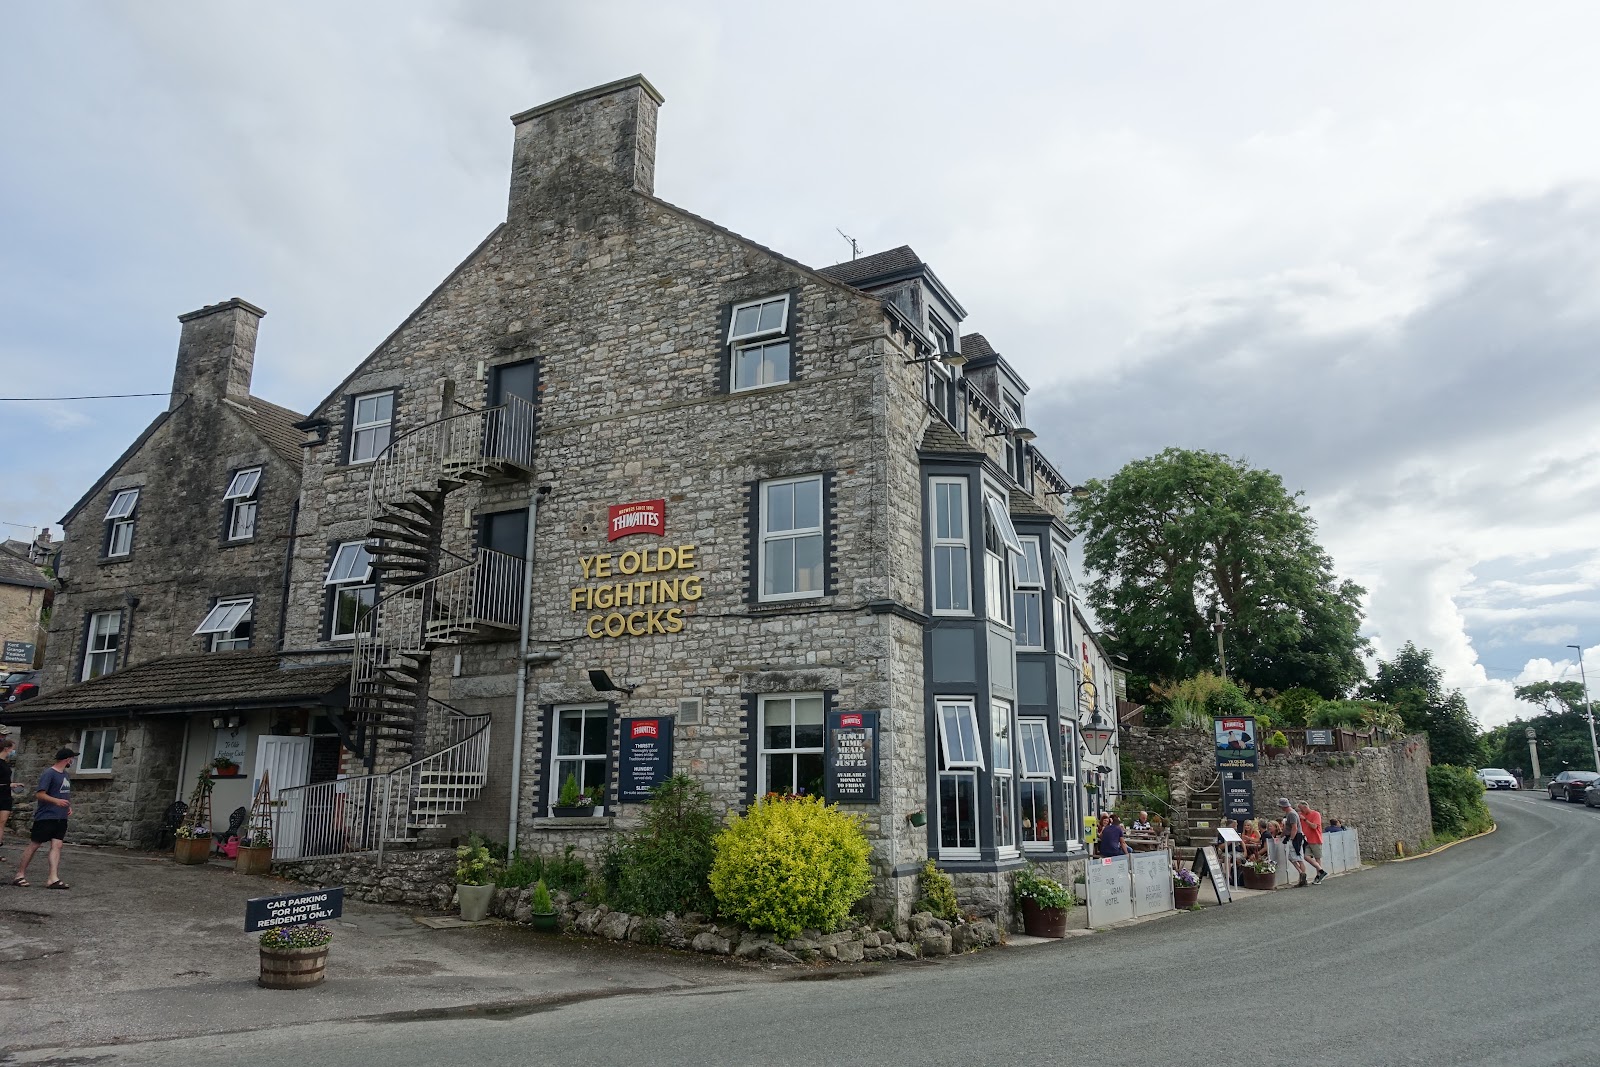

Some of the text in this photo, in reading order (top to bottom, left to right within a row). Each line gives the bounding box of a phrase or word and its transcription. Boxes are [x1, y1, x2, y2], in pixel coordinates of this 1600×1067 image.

[612, 512, 659, 532] THWAITES
[578, 544, 695, 580] YE OLDE
[571, 576, 703, 612] FIGHTING
[586, 608, 684, 639] COCKS
[634, 726, 656, 735] THWAITES
[267, 894, 328, 909] CAR PARKING
[272, 904, 321, 917] FOR HOTEL
[257, 909, 333, 927] RESIDENTS ONLY
